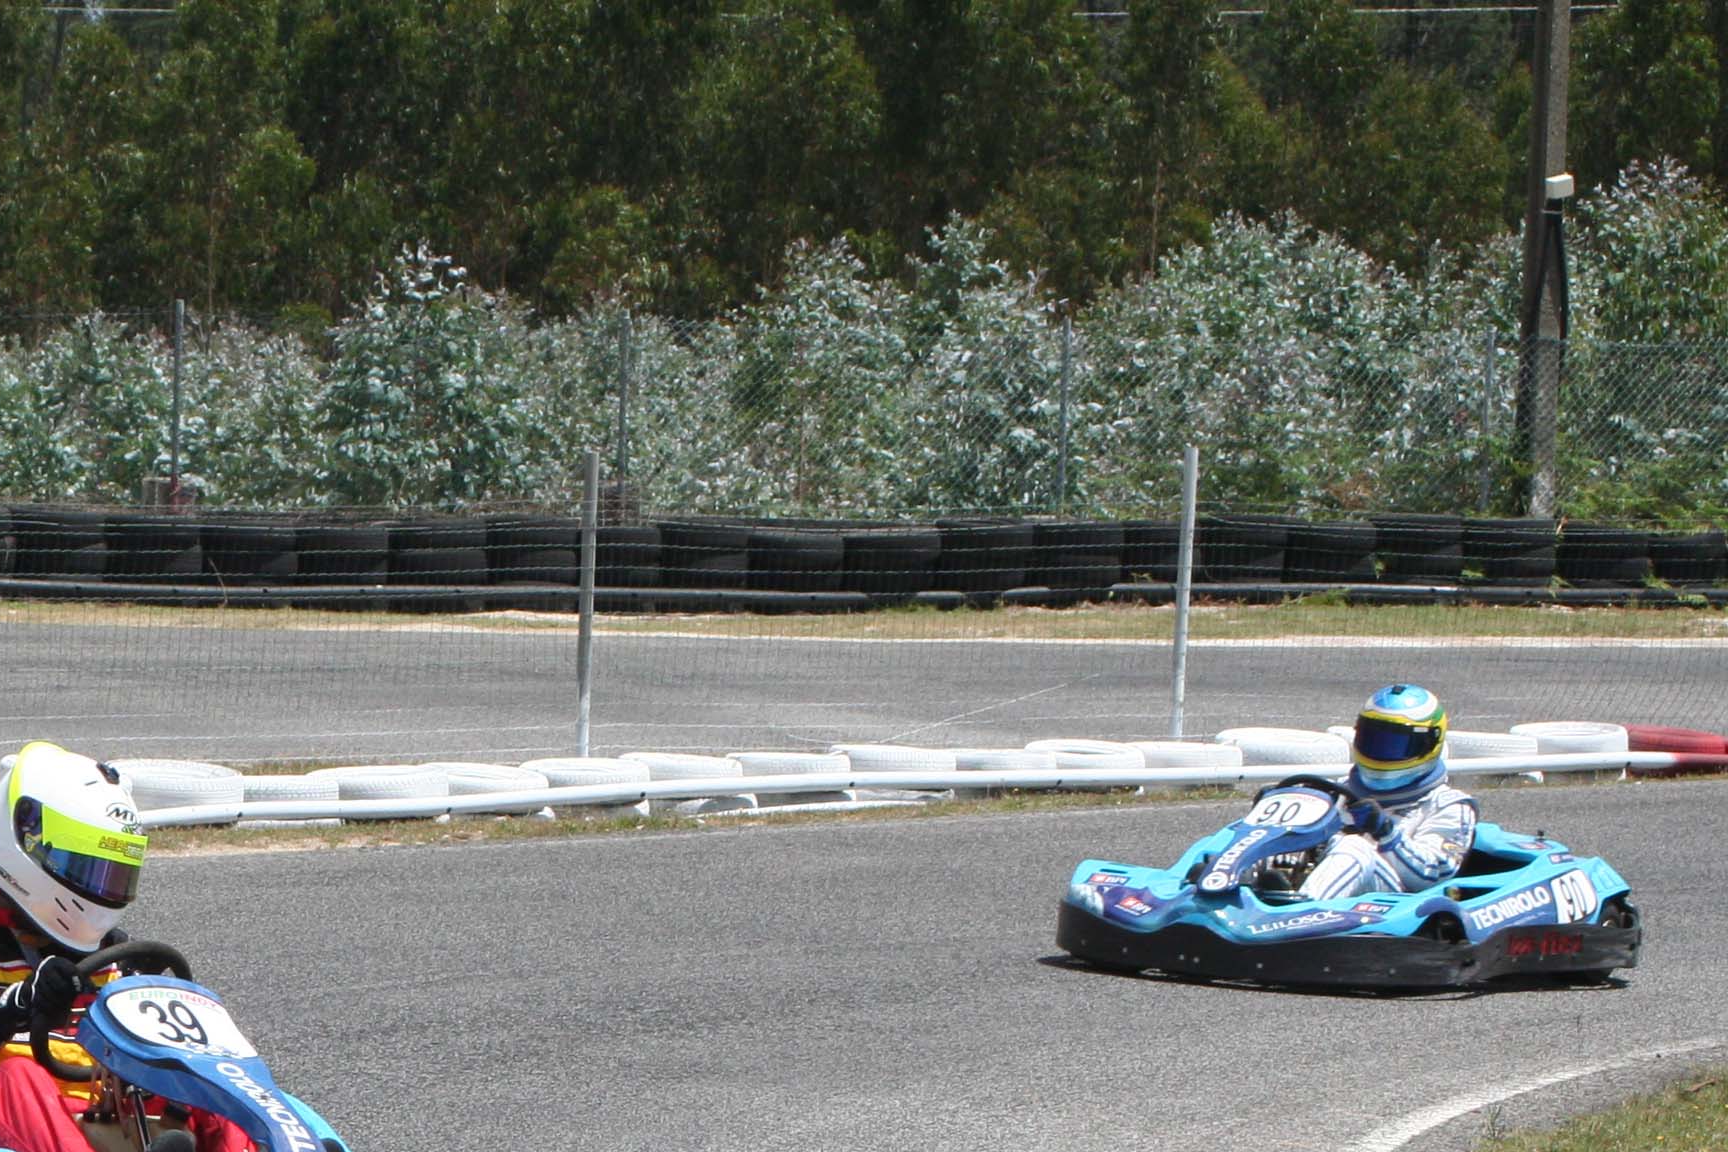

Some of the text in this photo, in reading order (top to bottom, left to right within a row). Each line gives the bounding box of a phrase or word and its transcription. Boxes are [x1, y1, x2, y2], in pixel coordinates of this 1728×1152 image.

[1256, 800, 1302, 824] 90
[1470, 886, 1552, 930] TECNIROLO
[138, 999, 209, 1046] 39
